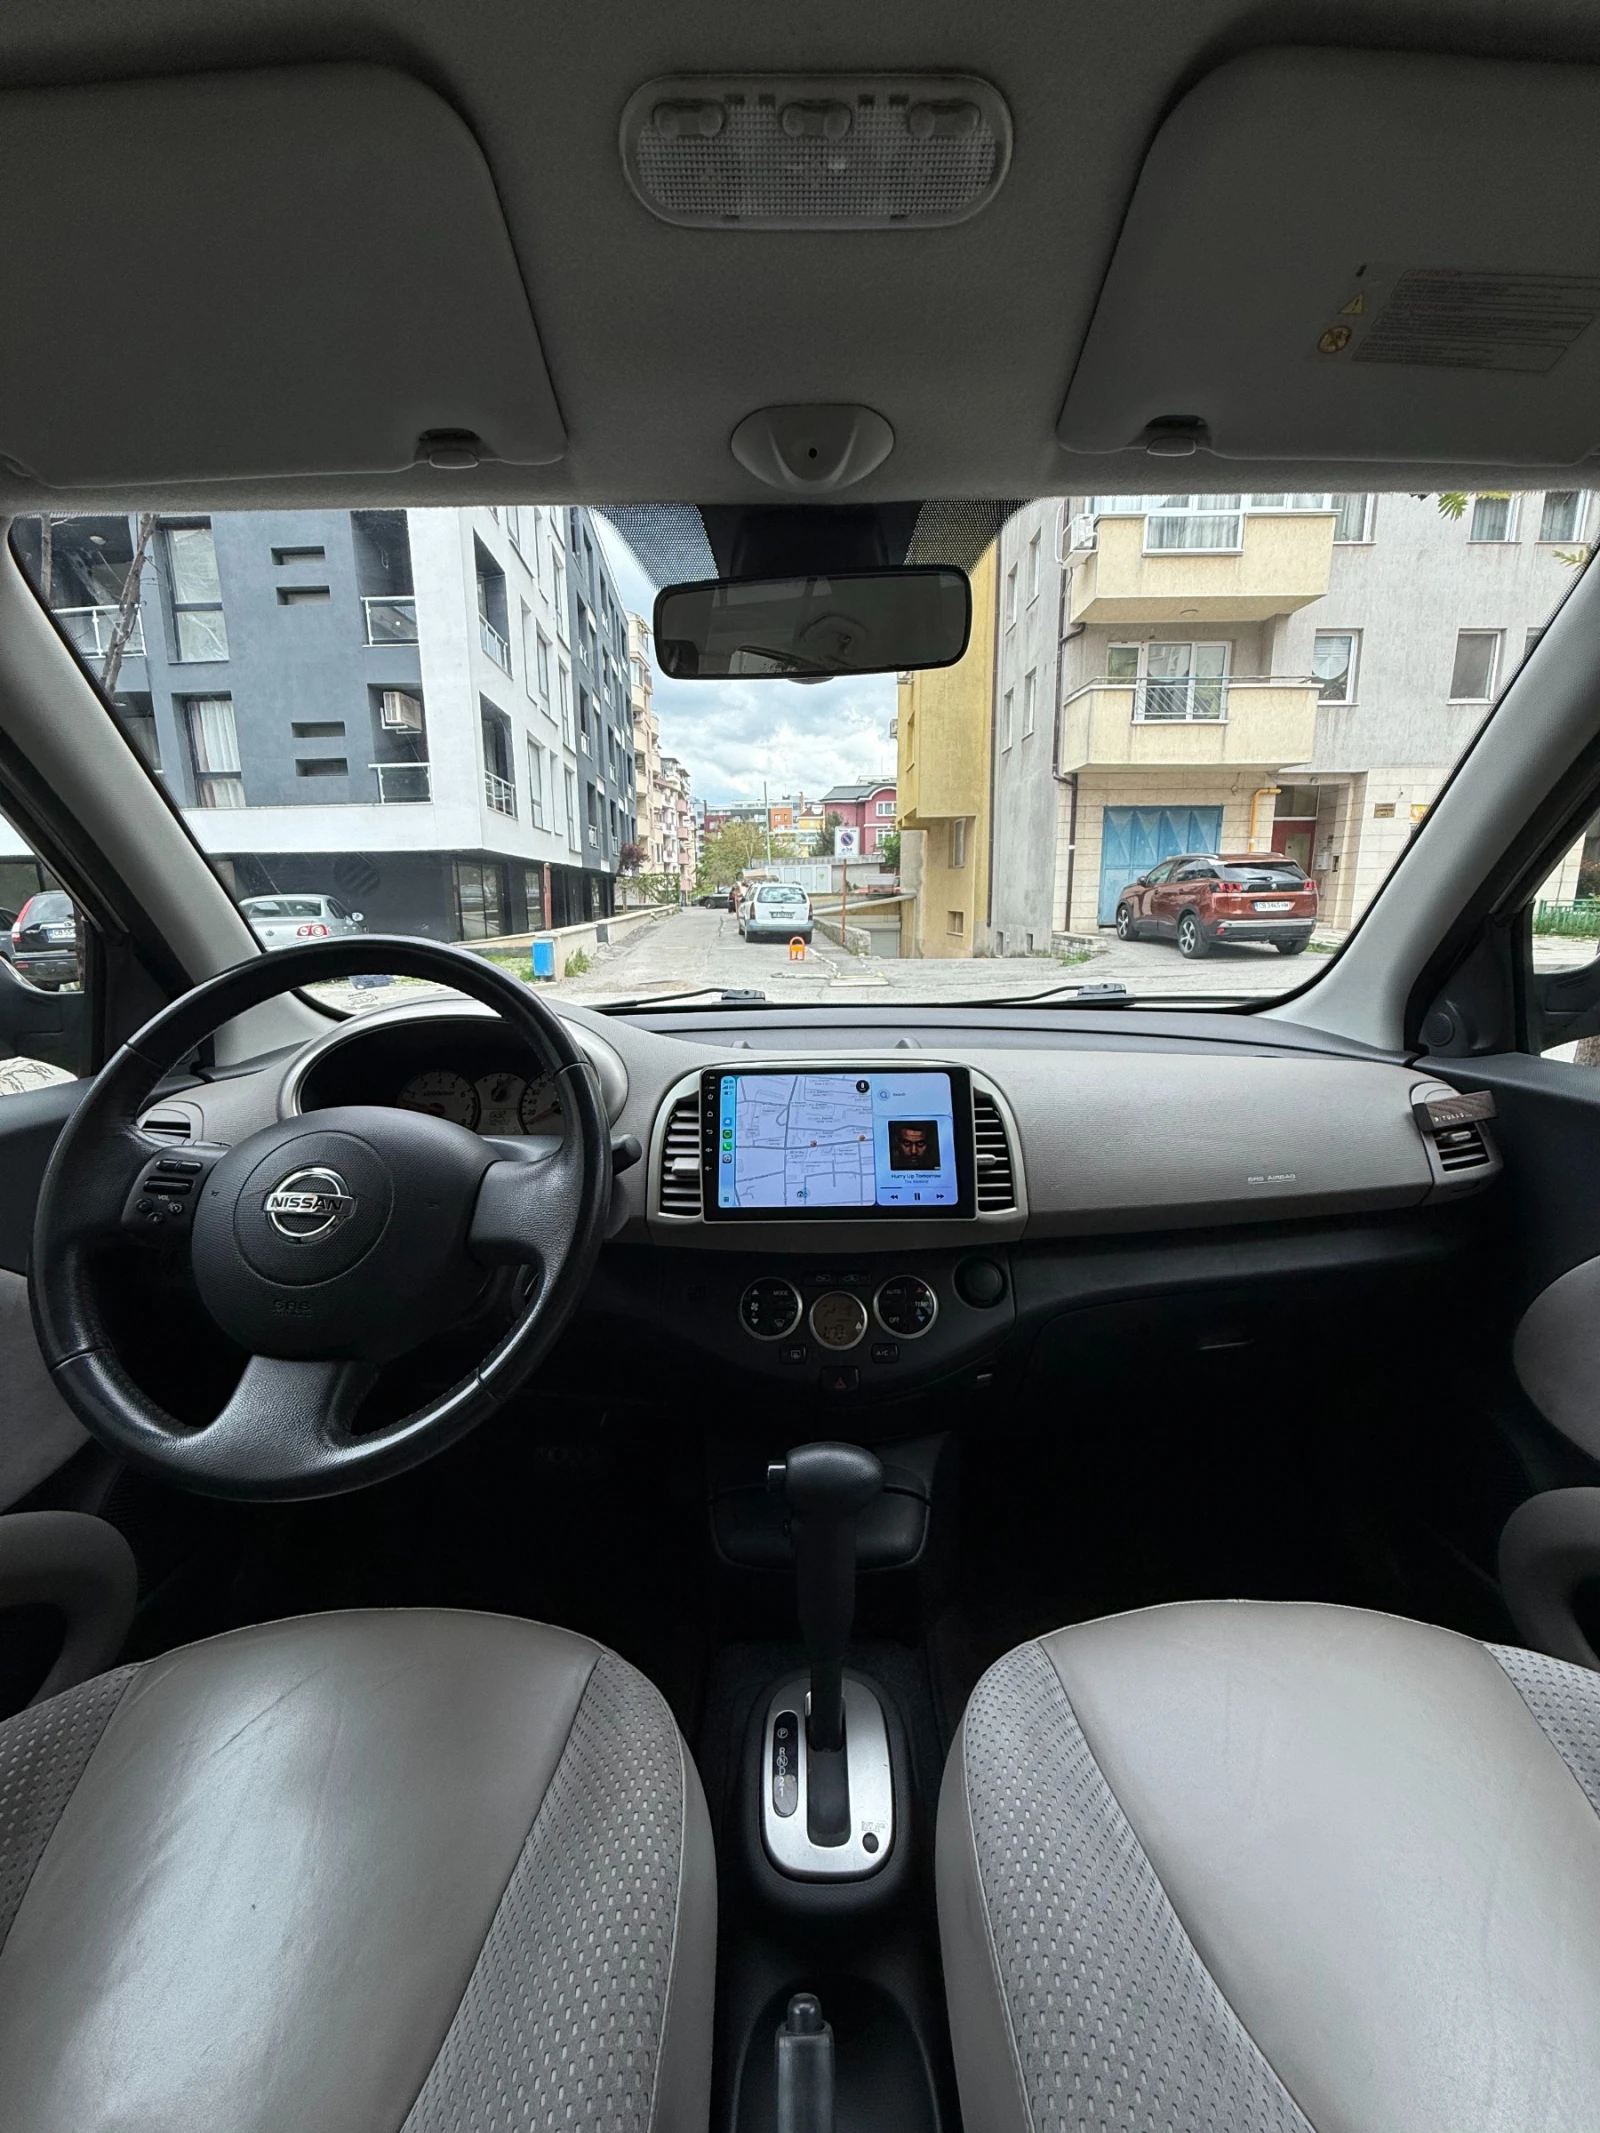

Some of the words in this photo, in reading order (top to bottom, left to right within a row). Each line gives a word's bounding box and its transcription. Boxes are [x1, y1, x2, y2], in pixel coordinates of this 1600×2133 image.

[1267, 1173, 1296, 1181] AIRBAG
[157, 1194, 170, 1202] VOL
[270, 1195, 344, 1212] NISSAN
[779, 1747, 786, 1756] R
[779, 1767, 786, 1776] D
[779, 1776, 785, 1787] 2
[779, 1788, 784, 1797] 1
